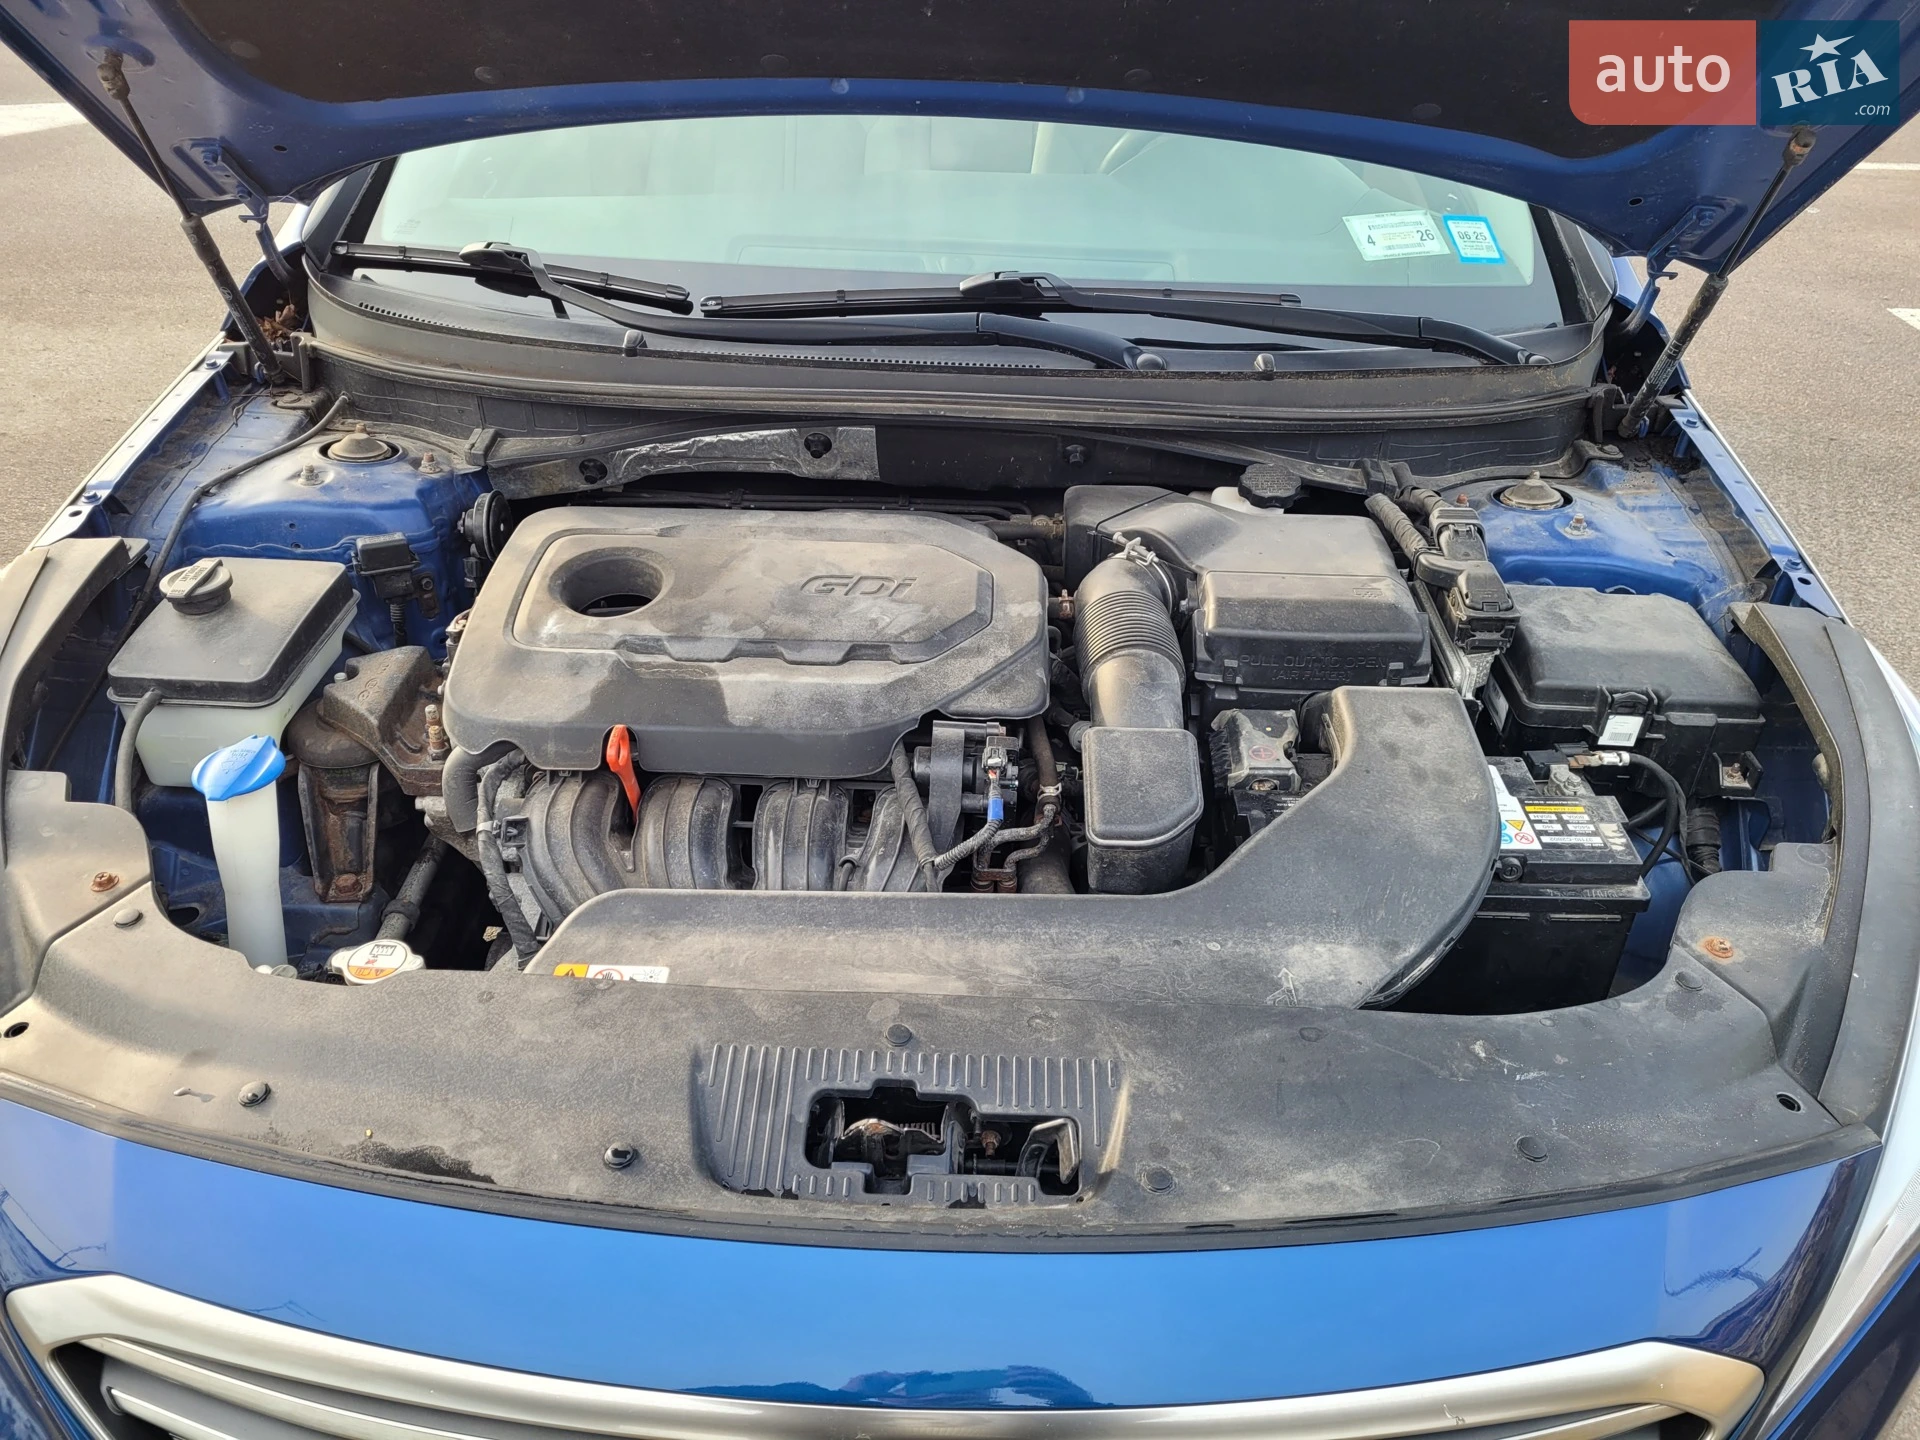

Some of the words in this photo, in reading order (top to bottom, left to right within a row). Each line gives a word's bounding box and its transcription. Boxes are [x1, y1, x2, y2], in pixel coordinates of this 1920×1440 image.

[1367, 234, 1376, 246] 4
[1416, 229, 1435, 242] 26
[1457, 231, 1471, 240] 06
[1473, 231, 1487, 241] 25
[1239, 653, 1280, 667] PULL
[1283, 655, 1317, 668] OUT
[1319, 656, 1340, 668] TO
[1344, 656, 1387, 668] OPEN
